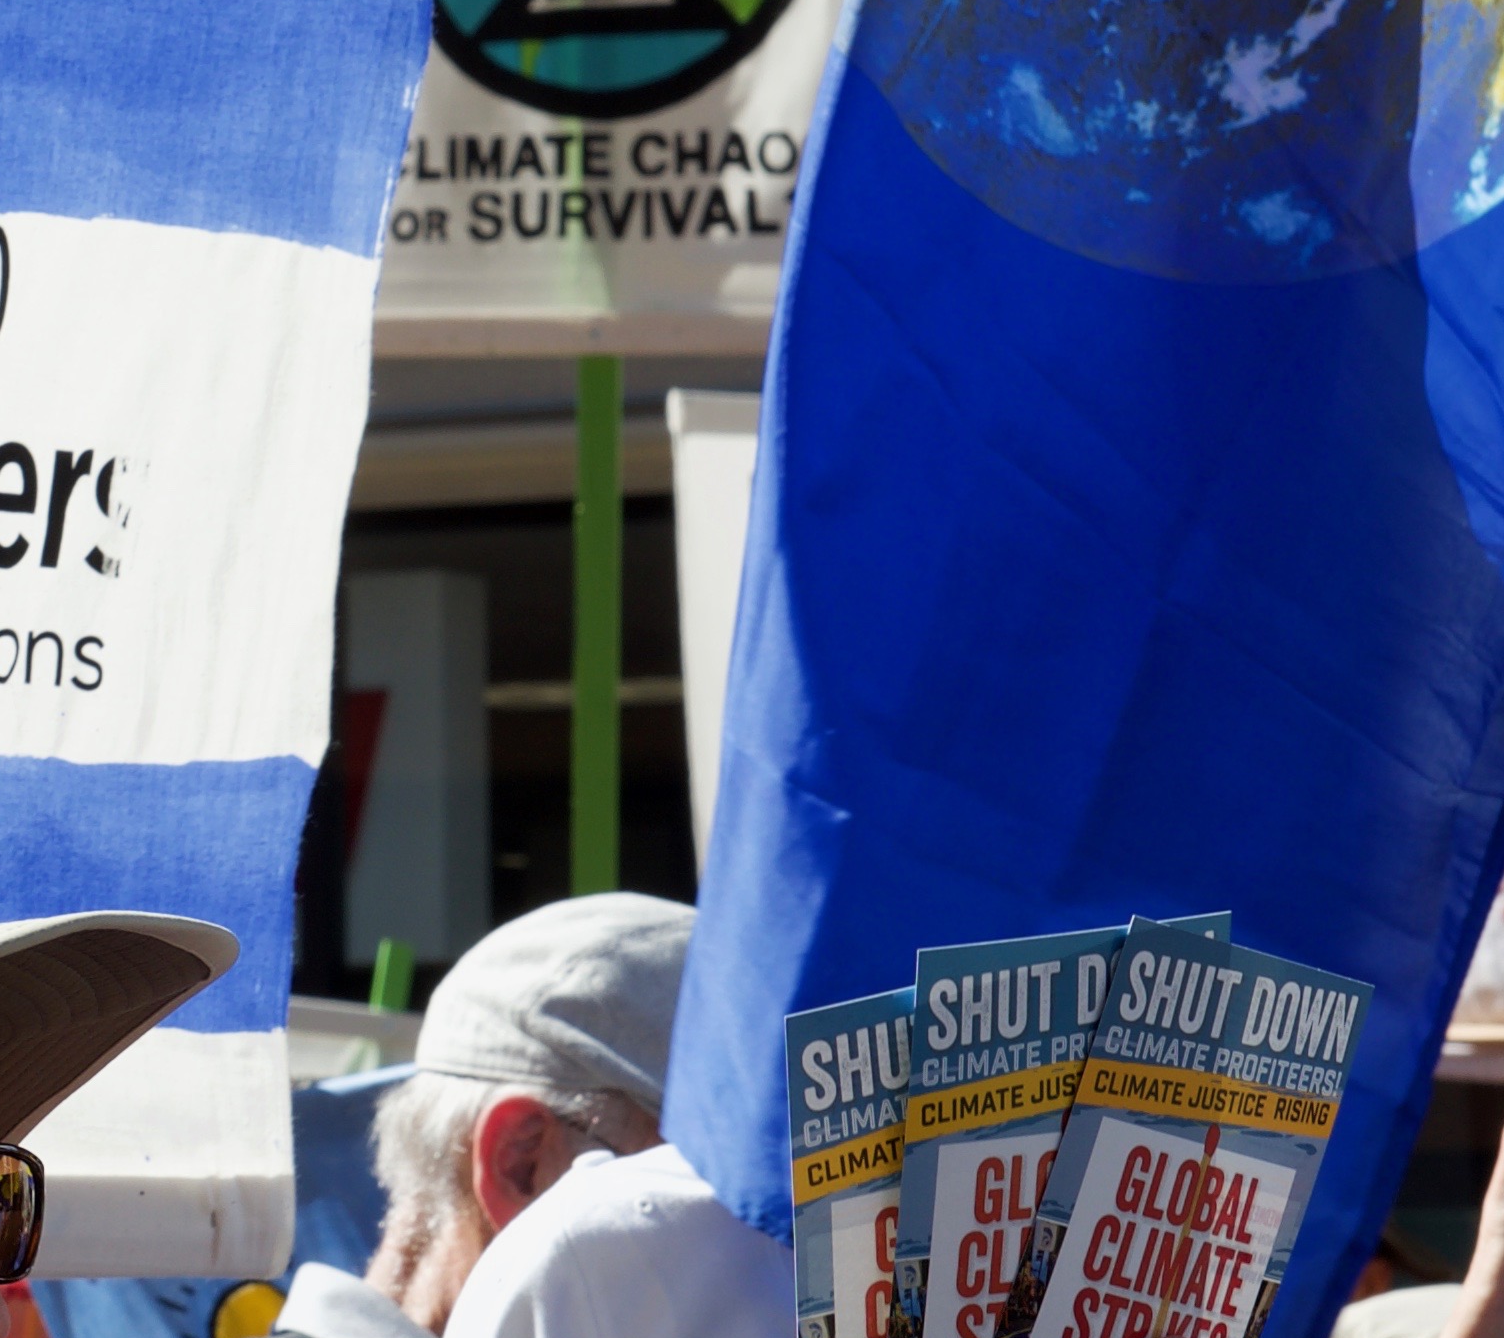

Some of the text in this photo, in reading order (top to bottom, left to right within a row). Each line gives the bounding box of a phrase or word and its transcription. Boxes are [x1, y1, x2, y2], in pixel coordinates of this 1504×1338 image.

[394, 208, 447, 243] OR
[927, 960, 1061, 1052] SHUT
[1119, 950, 1243, 1039] SHUT
[1241, 975, 1359, 1064] DOWN
[802, 1014, 914, 1113] SHU
[921, 1040, 1042, 1087] CLIMATE
[1094, 1069, 1331, 1126] CLIMATE JUSTICE RISING
[1105, 1026, 1343, 1098] CLIMATE PROFITEERS!
[920, 1083, 1025, 1128] CLIMATE
[807, 1135, 905, 1187] CLIMAT
[1116, 1145, 1259, 1245] GLOBAL
[1082, 1215, 1253, 1317] CLIMATE
